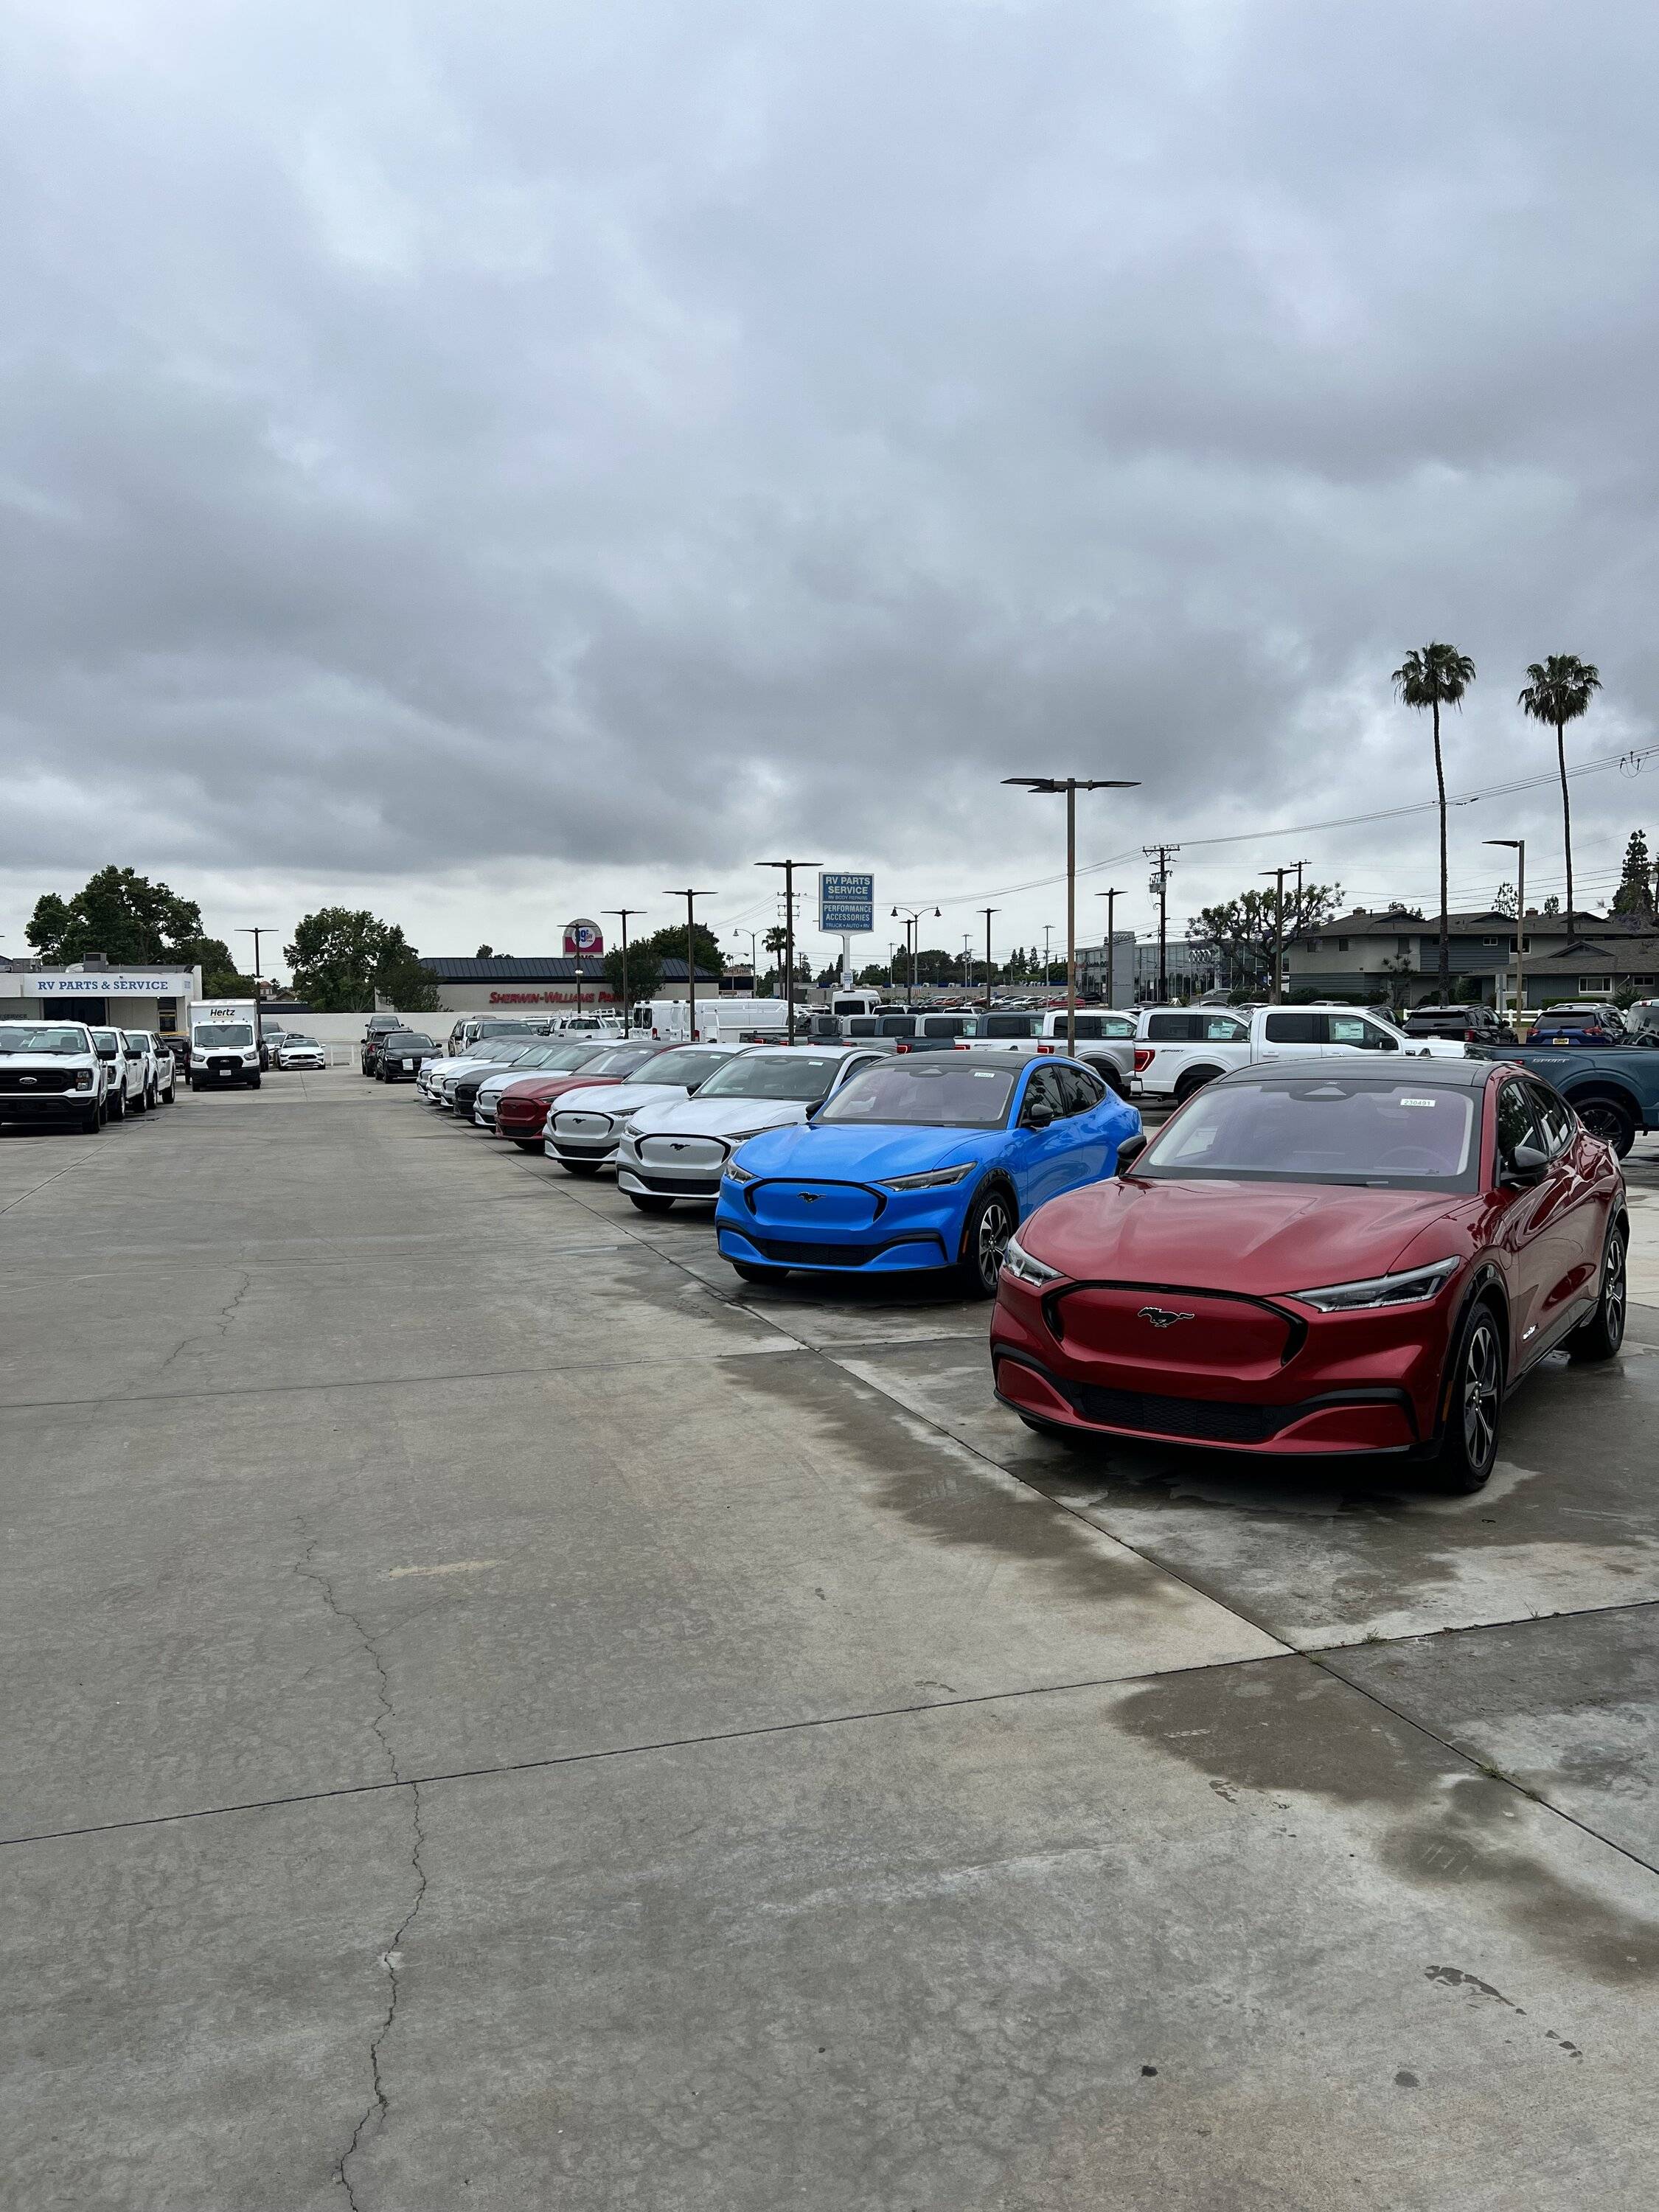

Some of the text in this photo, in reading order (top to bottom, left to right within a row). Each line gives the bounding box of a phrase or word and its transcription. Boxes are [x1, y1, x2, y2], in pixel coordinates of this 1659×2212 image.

[841, 877, 870, 885] PARTS
[828, 886, 868, 894] SERVICE
[38, 981, 54, 990] RV
[59, 981, 98, 990] PARTS
[114, 981, 168, 990] SERVICE
